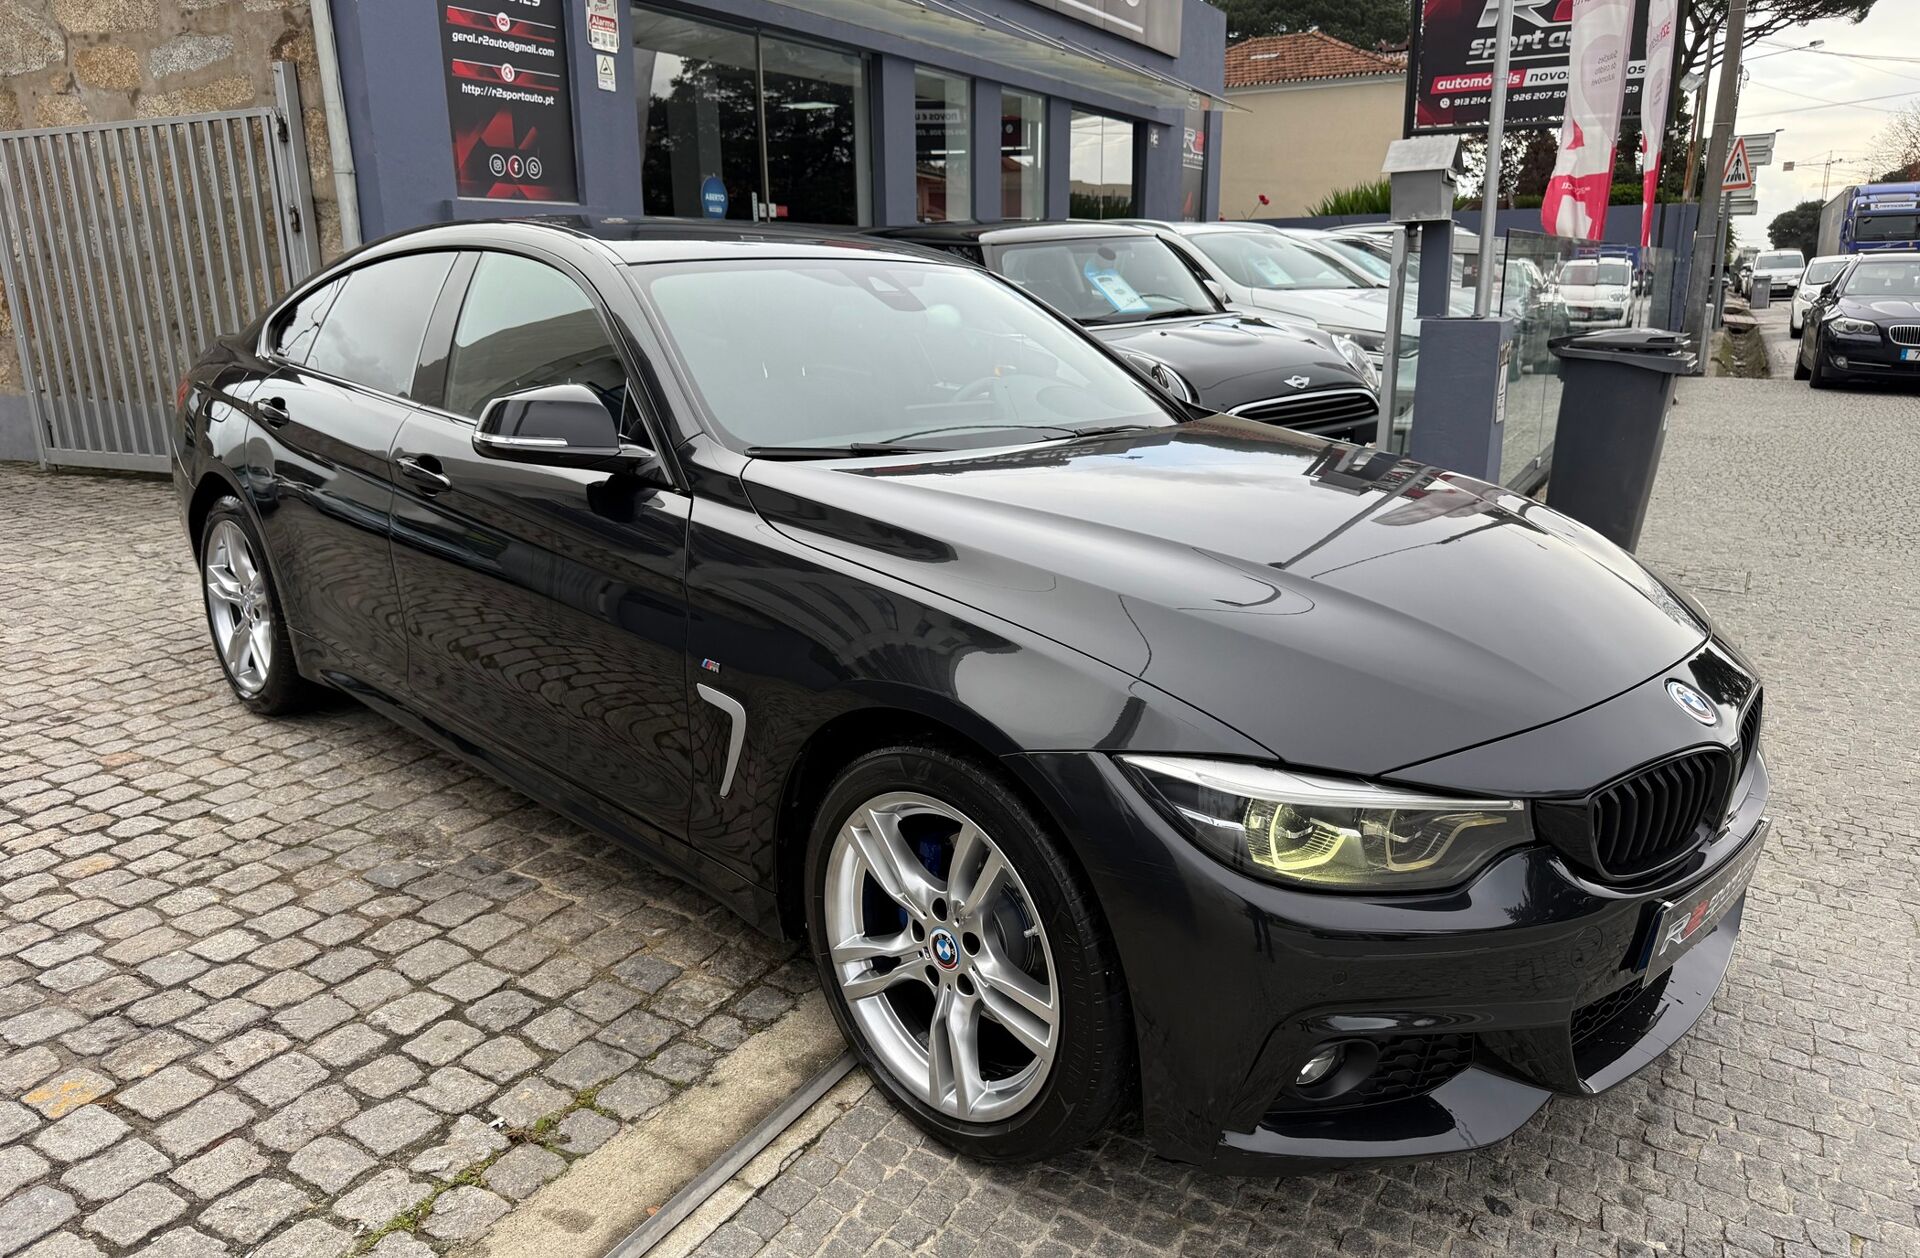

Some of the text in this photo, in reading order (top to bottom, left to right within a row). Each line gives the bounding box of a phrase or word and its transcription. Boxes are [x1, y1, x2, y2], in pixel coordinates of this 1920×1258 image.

[452, 32, 555, 57] geral.r2auto@gmail.com
[1437, 73, 1520, 90] automóis
[462, 83, 554, 106] http://r2sportauto.pt
[1454, 98, 1469, 107] 913
[1471, 97, 1487, 105] 214
[1512, 93, 1531, 102] 926
[1533, 91, 1552, 100] 207
[1554, 90, 1567, 98] 50
